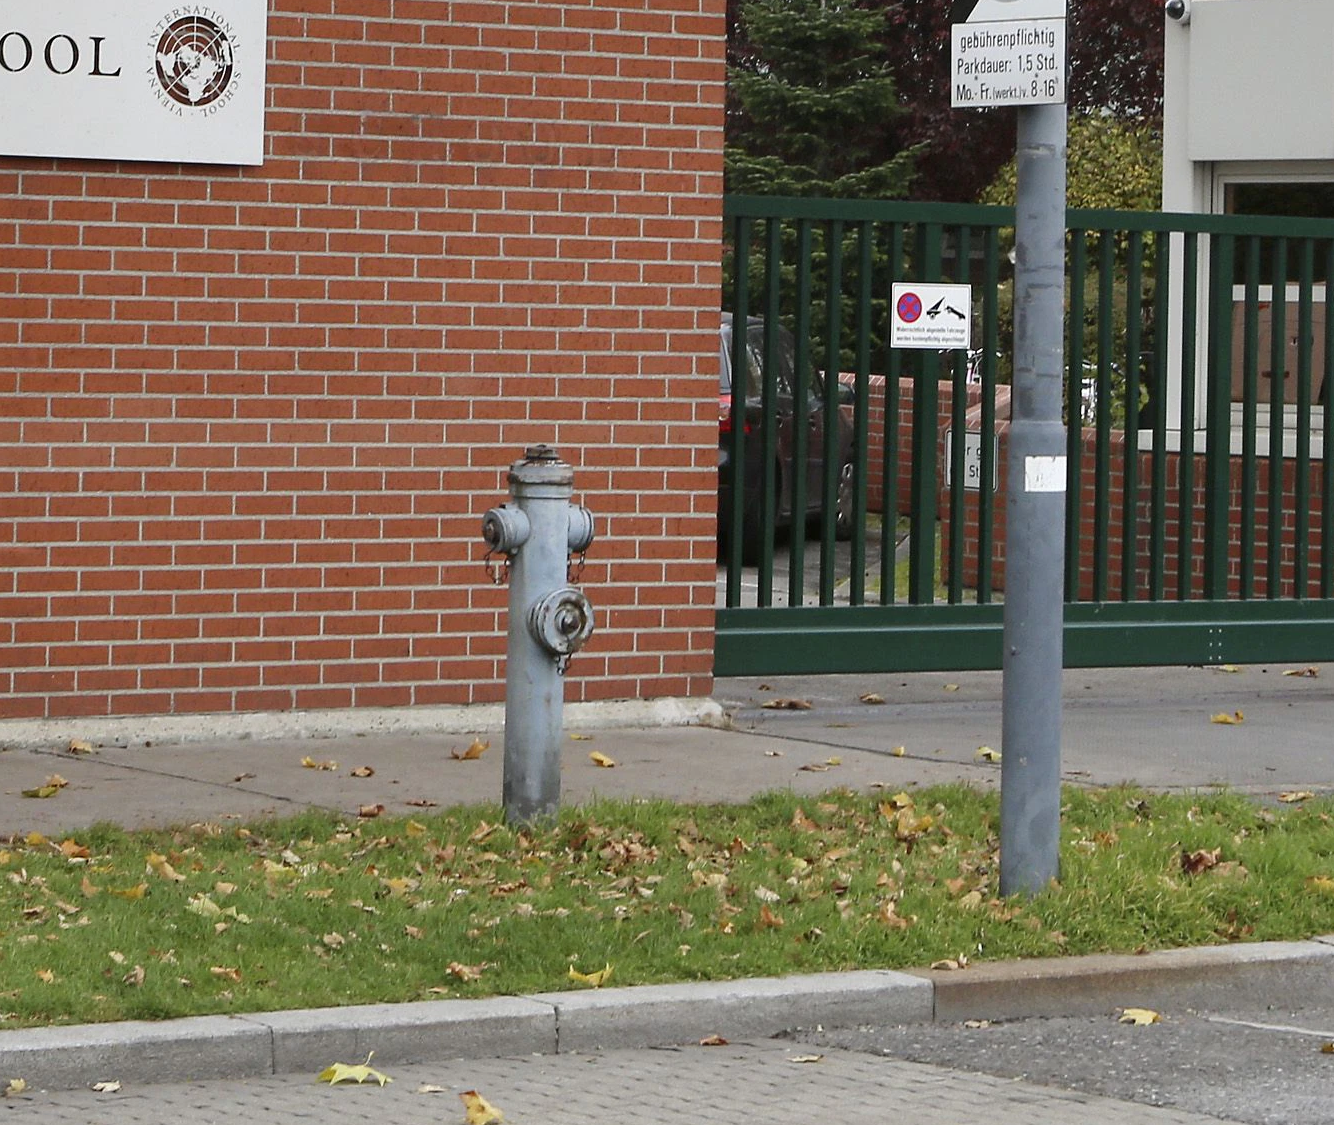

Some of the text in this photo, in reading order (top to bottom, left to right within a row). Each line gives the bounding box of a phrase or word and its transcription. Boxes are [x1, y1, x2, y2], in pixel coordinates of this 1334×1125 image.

[960, 27, 1055, 53] gebührenpflichtig
[147, 5, 242, 117] VIENNA INTERNATIONAL SCHOOL
[957, 53, 1058, 75] Parkdauer: 1,5 Std.
